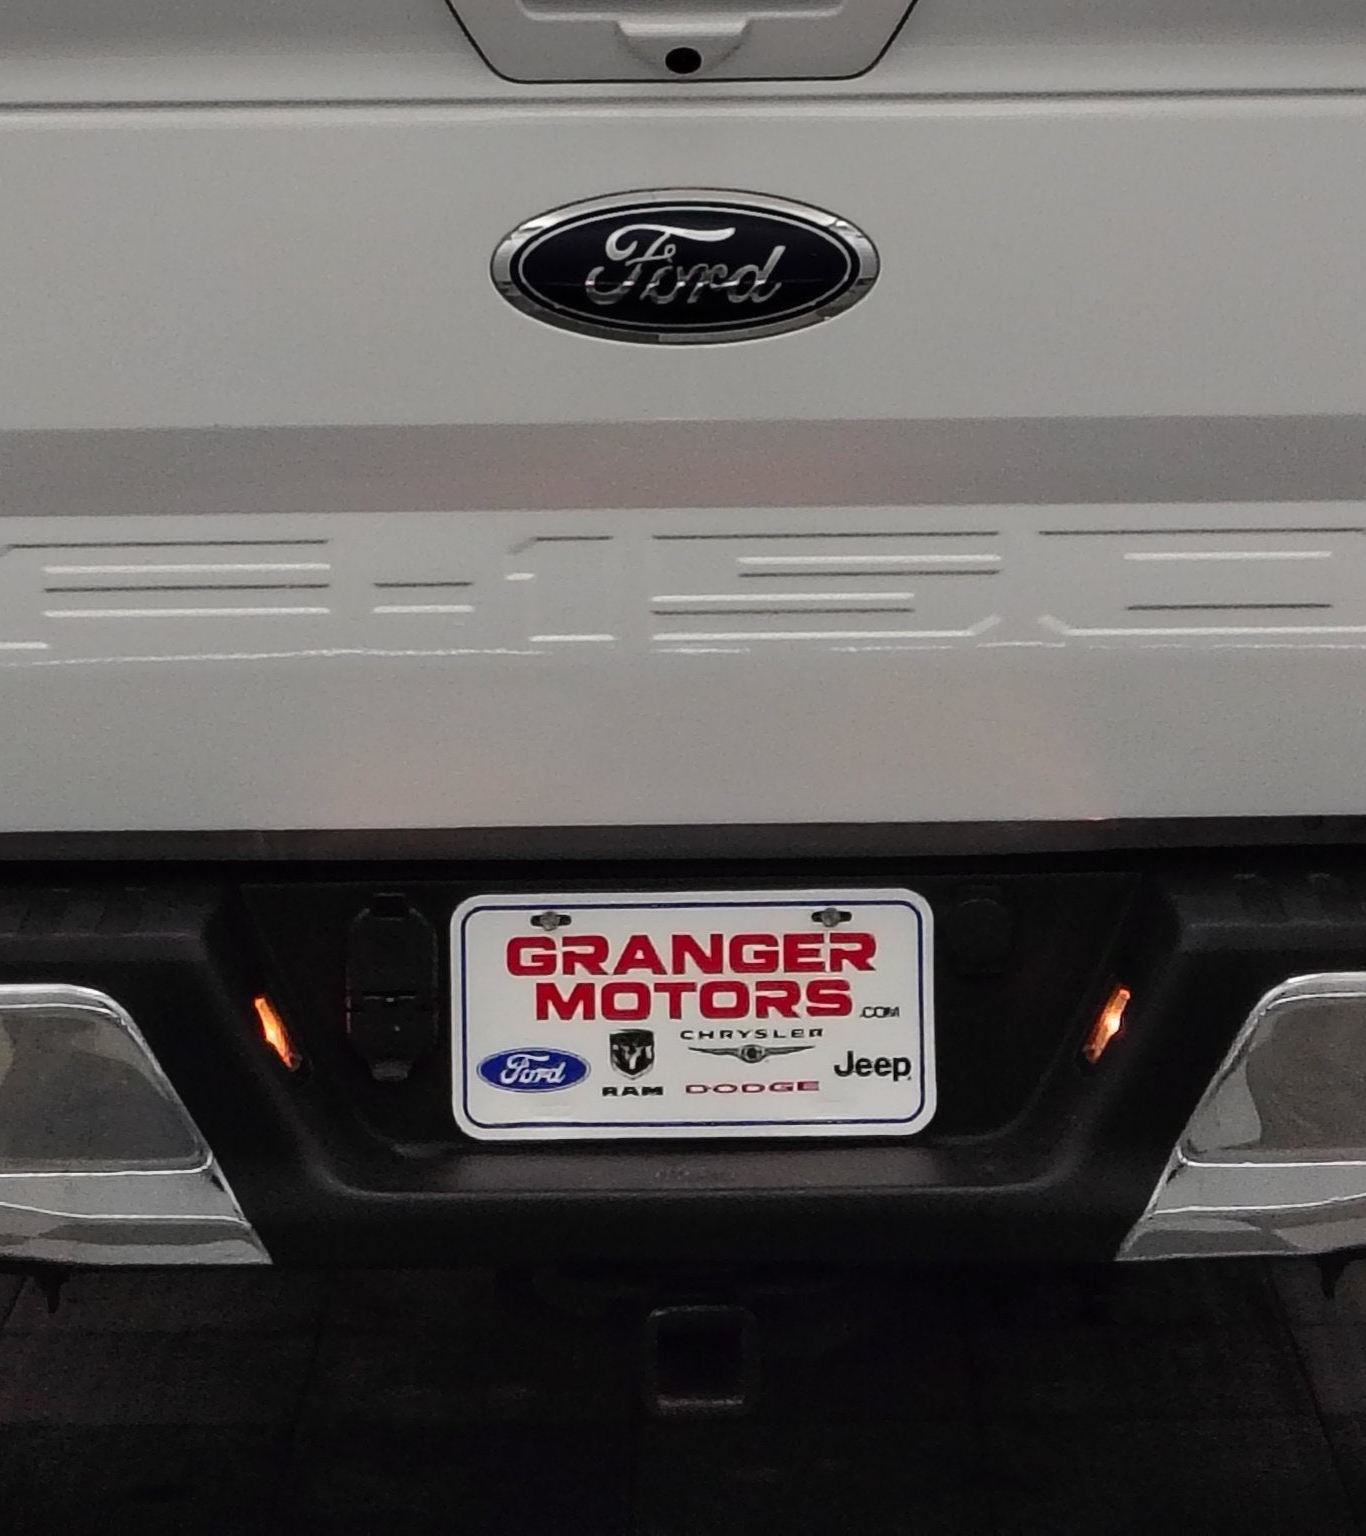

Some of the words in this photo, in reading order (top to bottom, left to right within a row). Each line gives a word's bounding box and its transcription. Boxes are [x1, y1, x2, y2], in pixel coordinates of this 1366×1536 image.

[584, 223, 786, 306] Ford
[505, 932, 877, 977] GRANGER
[535, 979, 854, 1021] MOTORS
[679, 1028, 824, 1040] CHRYSLER
[499, 1054, 567, 1086] Ford
[834, 1050, 912, 1082] Jeep
[602, 1085, 664, 1097] RAM
[685, 1080, 820, 1094] DODGE
